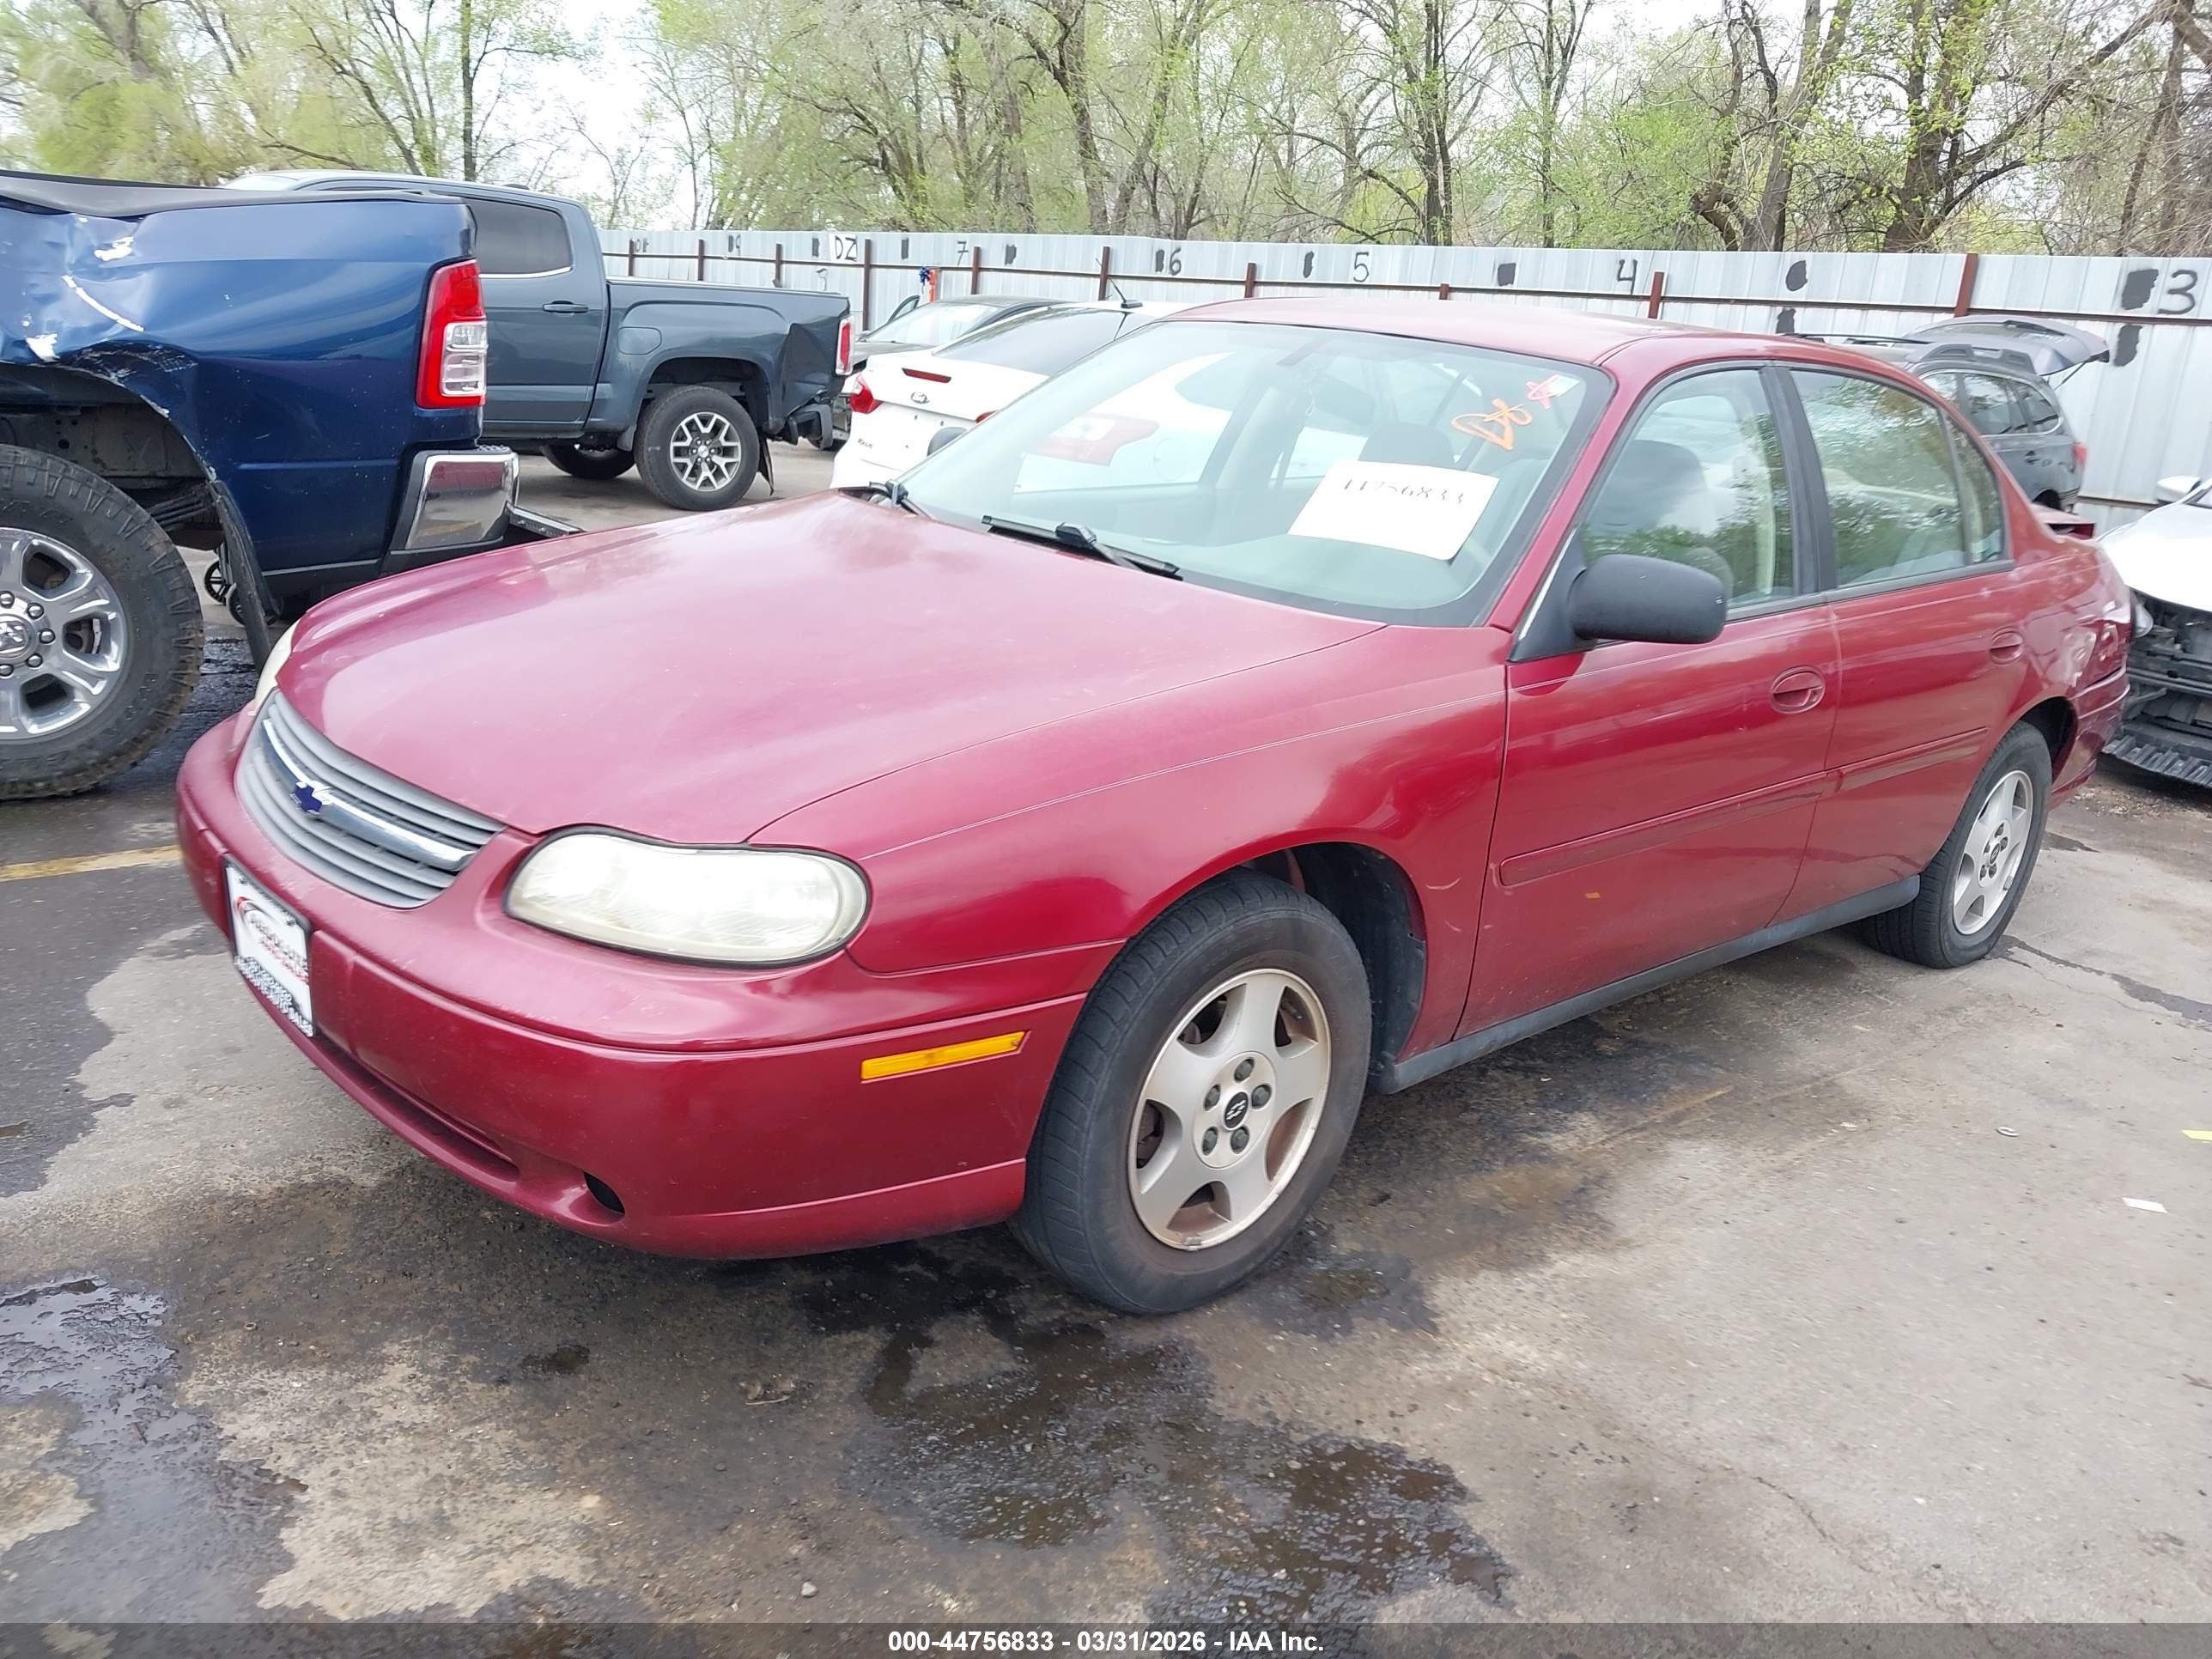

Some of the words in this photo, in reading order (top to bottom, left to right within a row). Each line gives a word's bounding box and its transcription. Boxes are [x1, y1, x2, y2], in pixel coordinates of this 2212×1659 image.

[957, 240, 969, 266] 7
[1169, 247, 1182, 276] 6
[1353, 252, 1370, 283] 5
[1617, 259, 1638, 295] 4
[2157, 269, 2198, 314] 3
